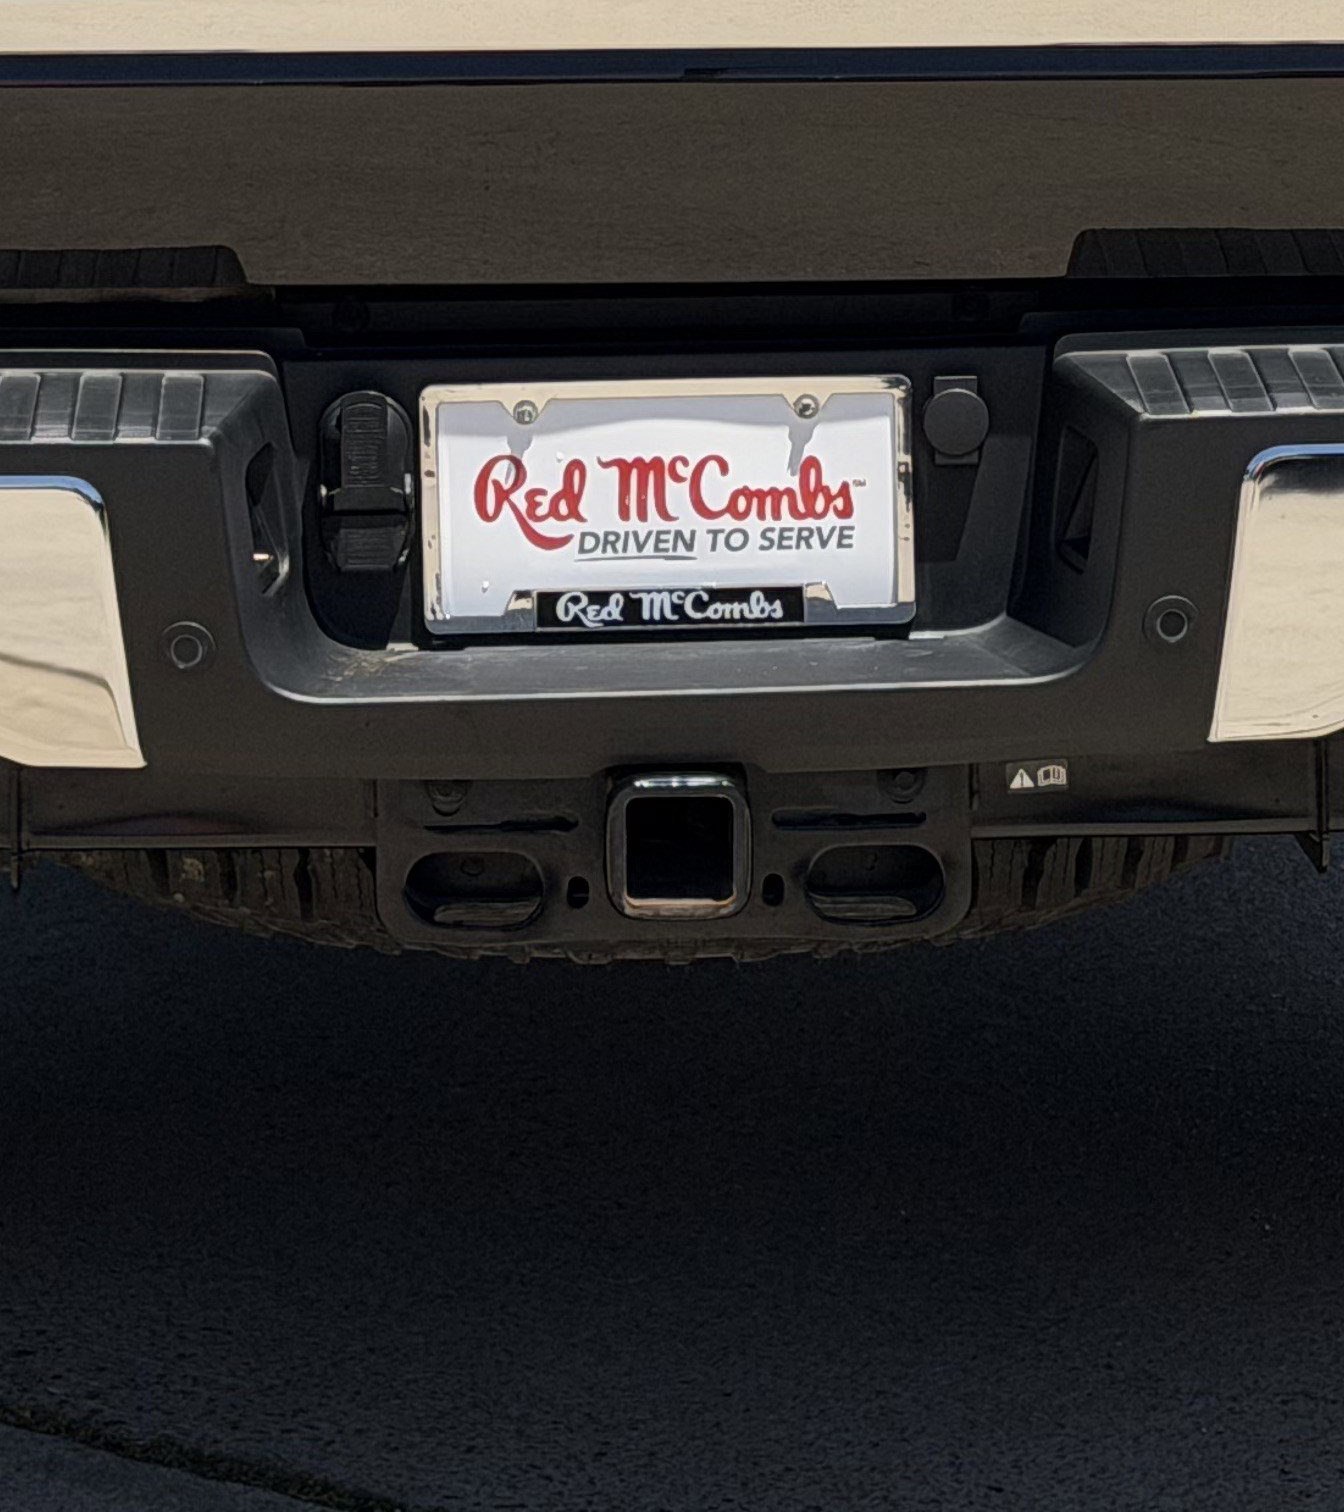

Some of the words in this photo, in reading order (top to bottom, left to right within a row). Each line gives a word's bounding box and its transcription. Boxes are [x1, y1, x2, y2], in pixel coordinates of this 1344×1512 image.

[474, 454, 588, 550] Red
[597, 454, 854, 522] McCombs
[577, 527, 697, 556] DRIVEN
[704, 527, 752, 553] TO
[758, 525, 856, 552] SERVE
[556, 592, 625, 628] Red
[630, 590, 784, 622] McCombs
